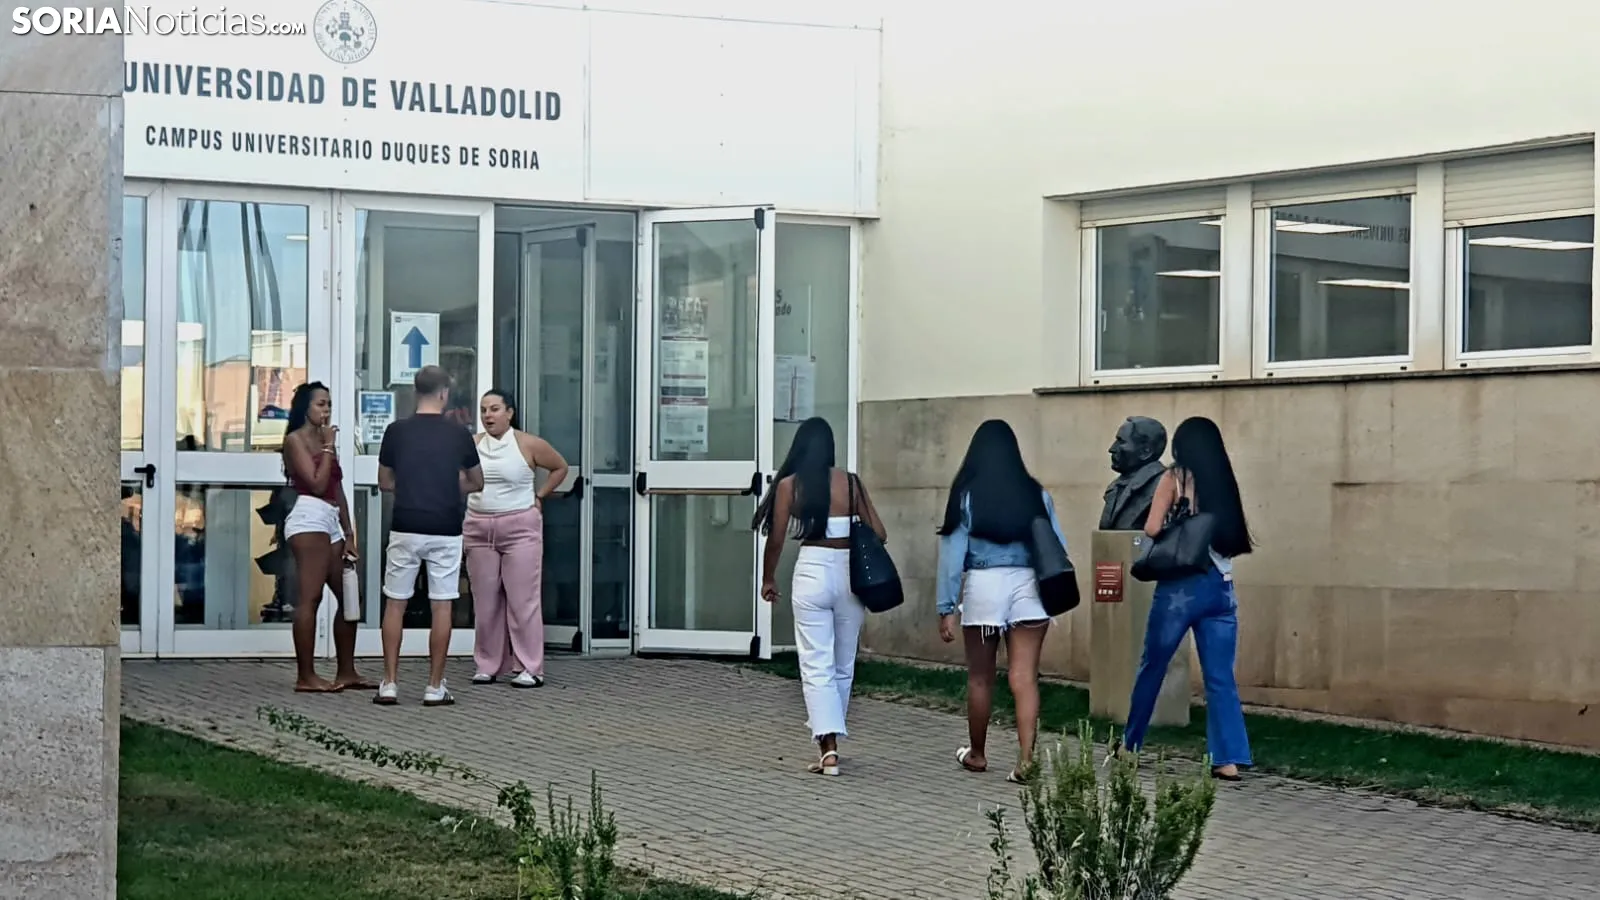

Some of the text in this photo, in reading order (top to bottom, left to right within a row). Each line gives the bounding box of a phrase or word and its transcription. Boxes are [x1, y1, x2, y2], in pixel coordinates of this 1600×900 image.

[124, 61, 562, 121] UNIVERSIDAD DE VALLADOLID
[145, 125, 540, 170] CAMPUS UNIVERSITARIO DUQUES DE SORIA
